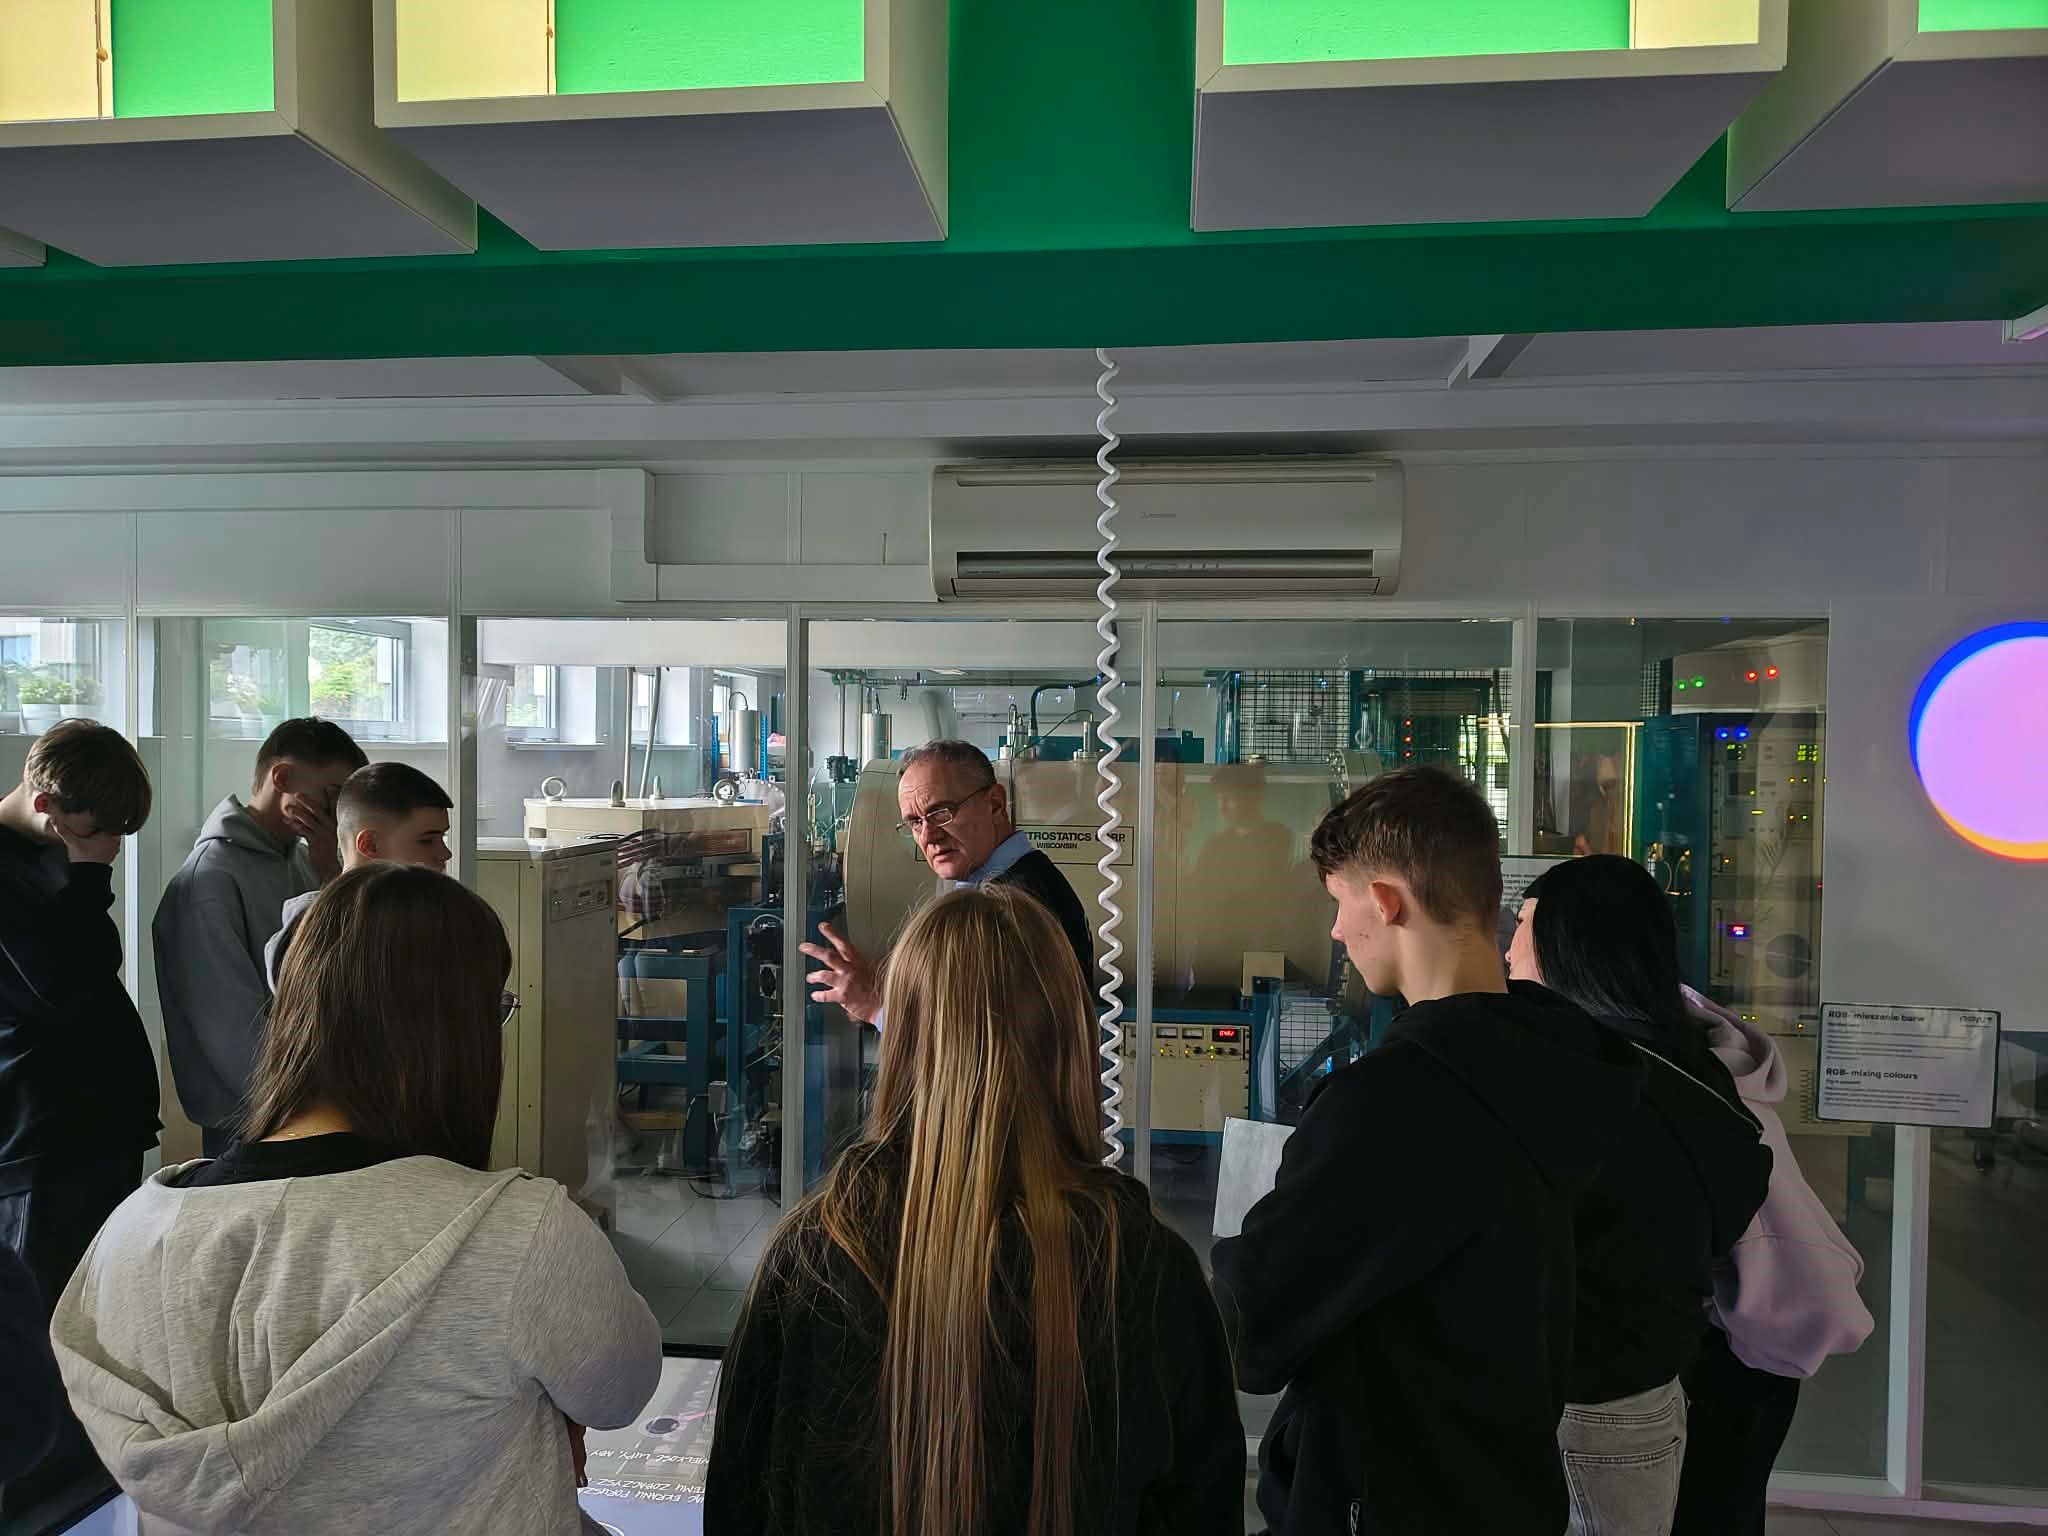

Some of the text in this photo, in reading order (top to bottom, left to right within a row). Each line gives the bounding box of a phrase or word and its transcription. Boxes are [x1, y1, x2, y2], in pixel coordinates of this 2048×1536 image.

[1025, 831, 1091, 841] TROSTATICS
[1851, 1069, 1882, 1080] mixing
[1883, 1072, 1919, 1080] colours
